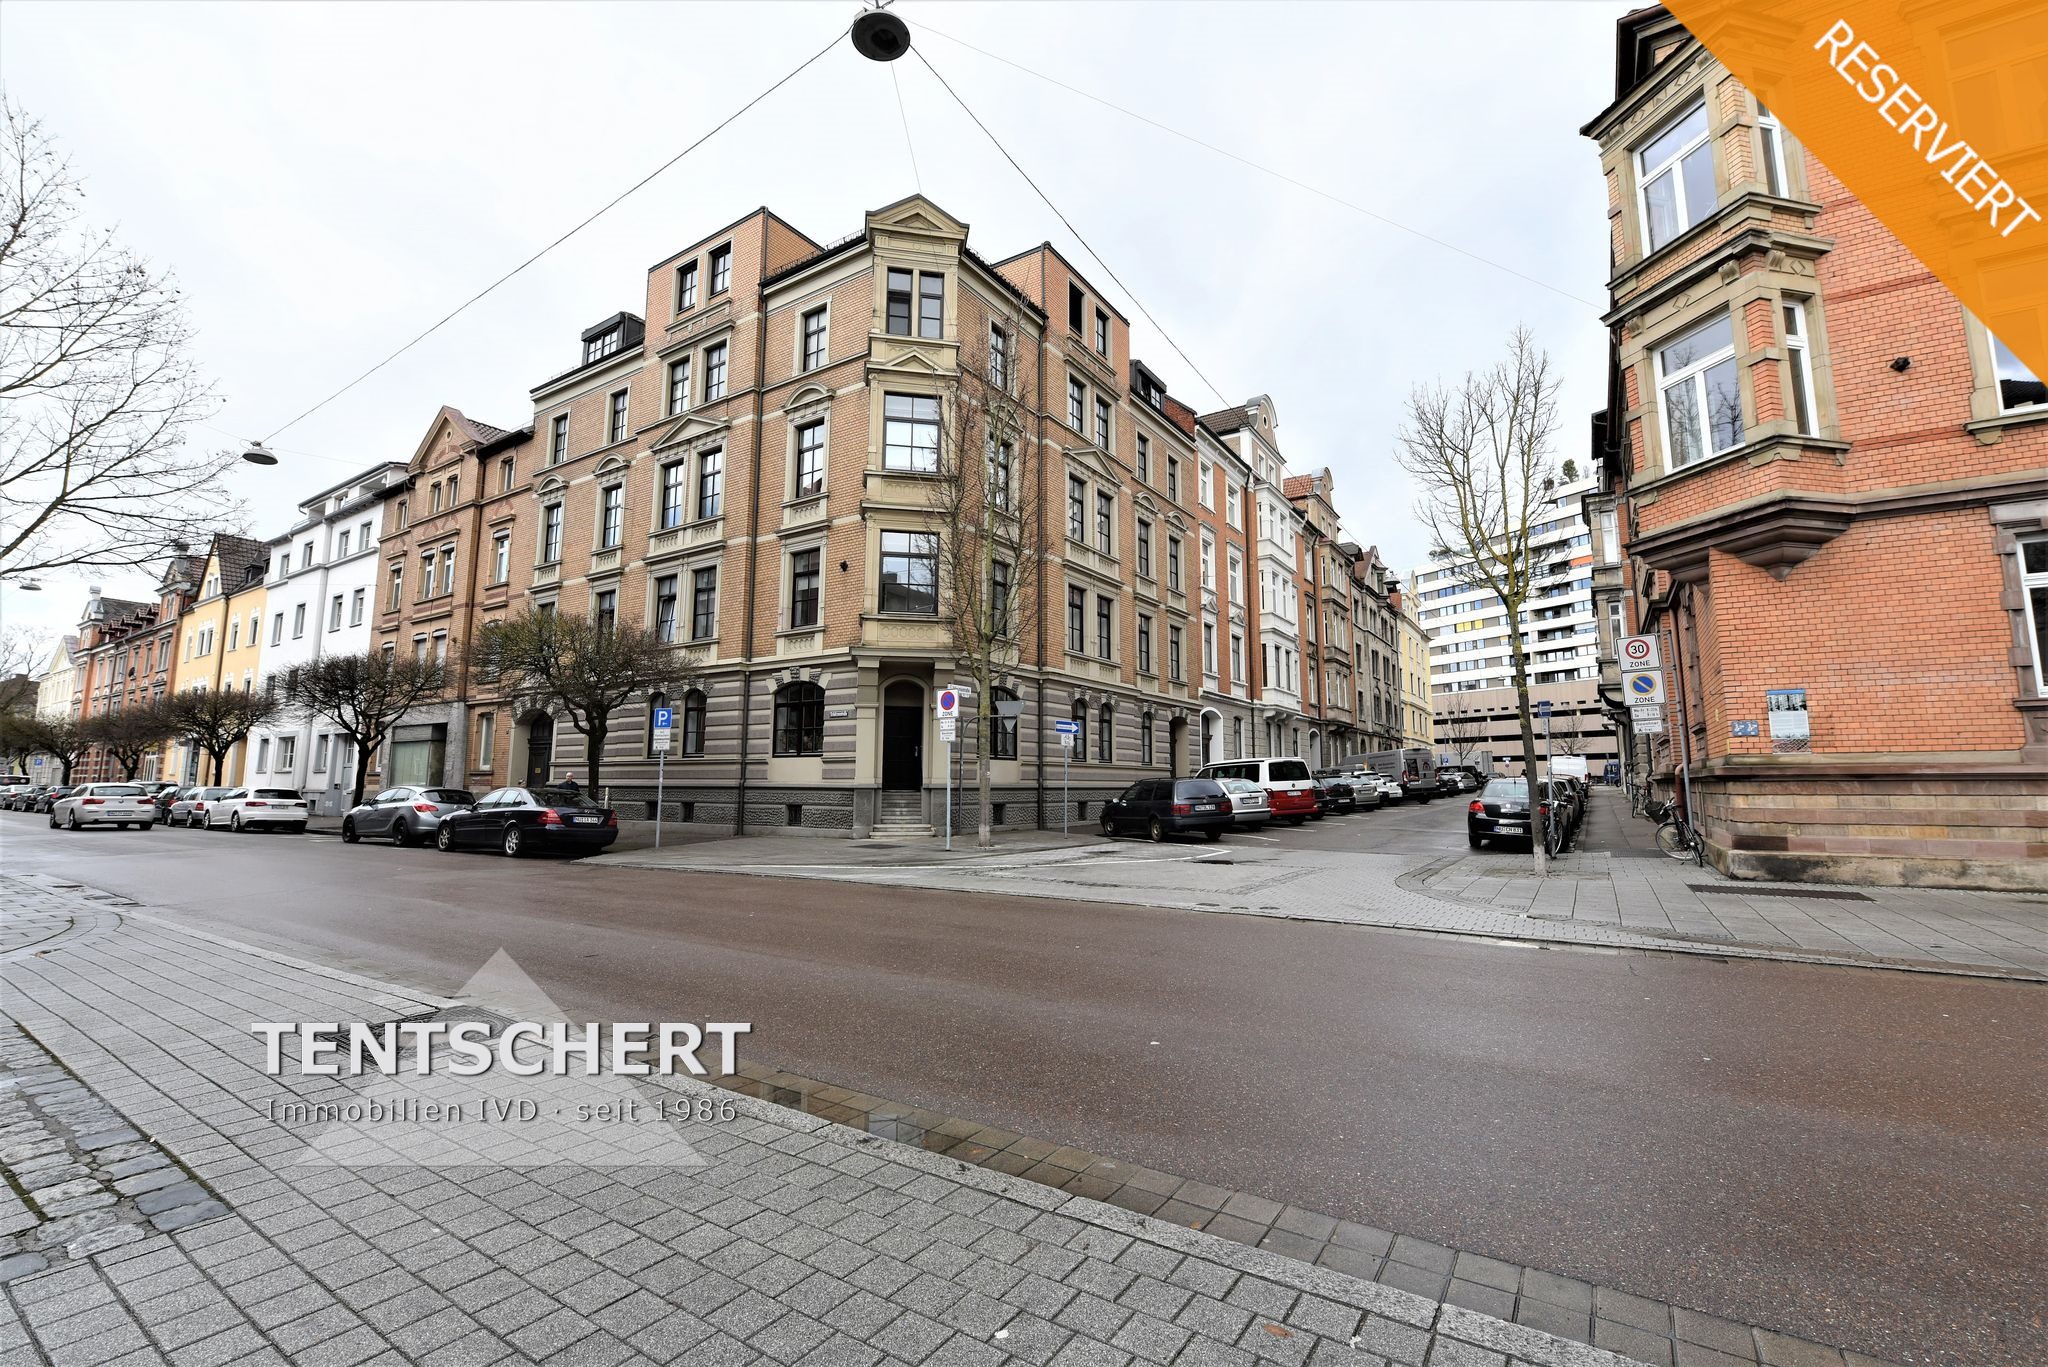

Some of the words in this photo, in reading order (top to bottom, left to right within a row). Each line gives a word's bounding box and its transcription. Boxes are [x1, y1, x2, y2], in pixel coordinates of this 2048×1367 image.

[1630, 644, 1645, 655] 30
[1629, 660, 1651, 668] ZONE
[657, 710, 669, 727] P
